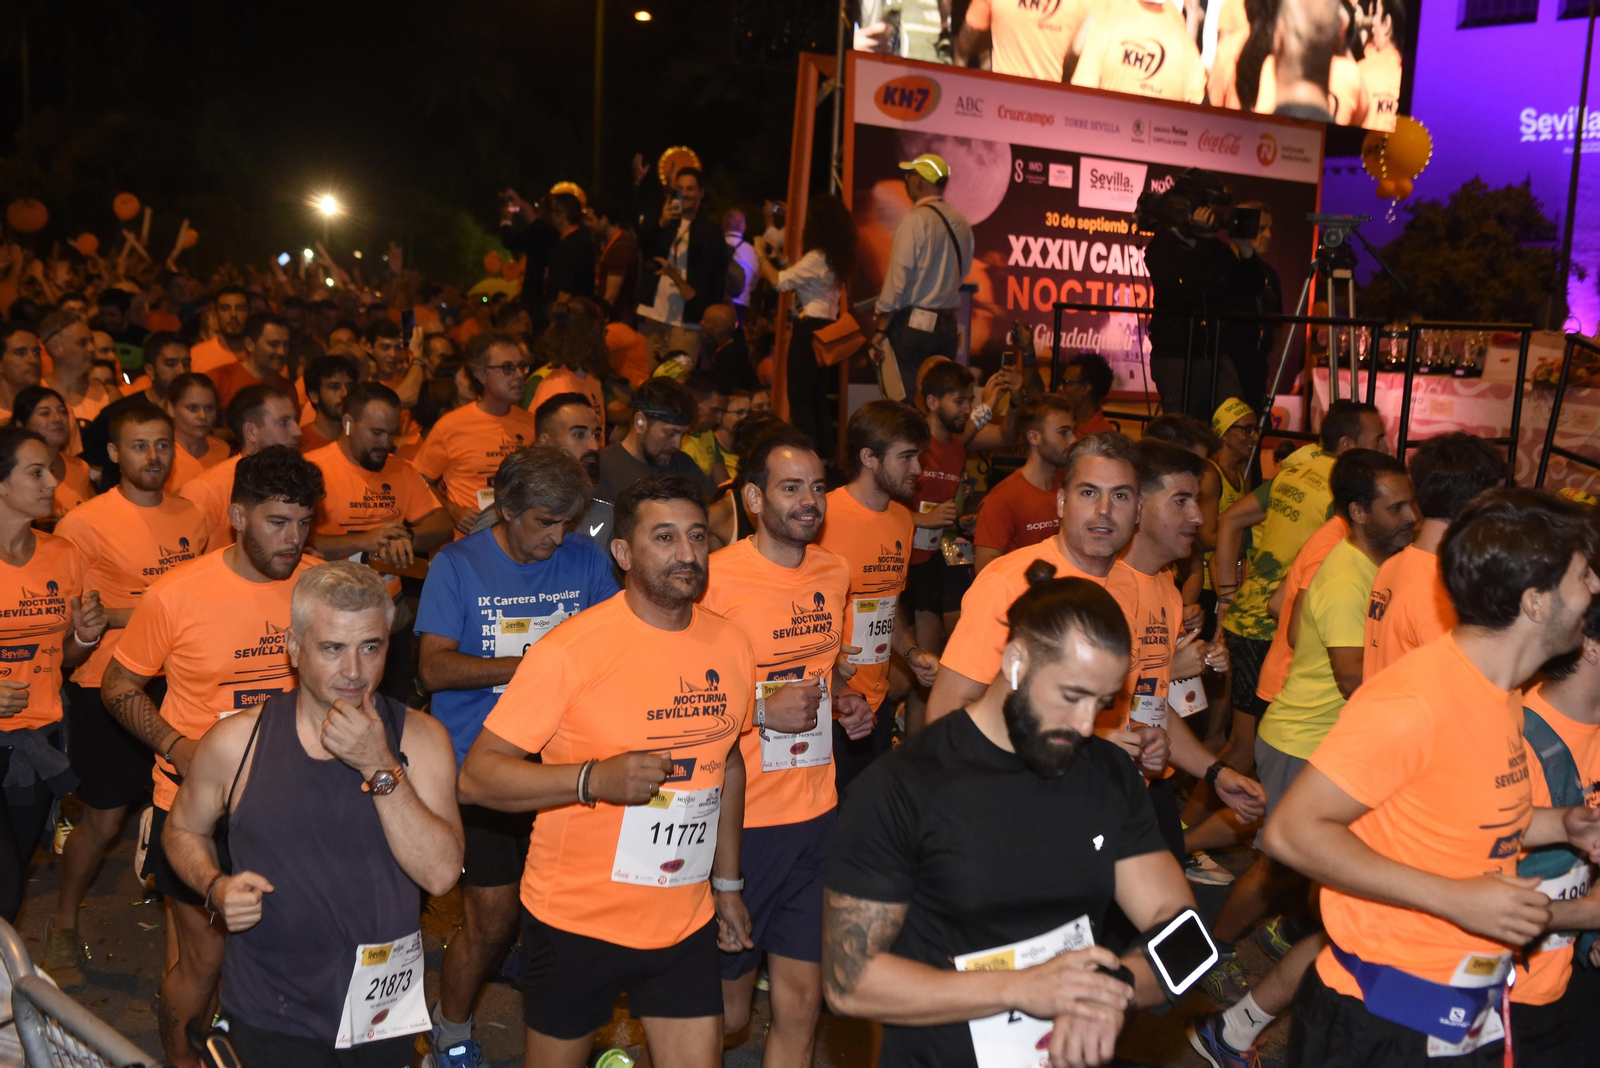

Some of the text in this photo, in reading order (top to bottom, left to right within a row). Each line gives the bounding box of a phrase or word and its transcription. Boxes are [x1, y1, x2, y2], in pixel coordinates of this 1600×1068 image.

[1122, 49, 1156, 73] KH7
[955, 96, 985, 113] ABC
[997, 105, 1055, 127] Cruzcampo
[1064, 117, 1120, 134] TORRE SEVILLA
[1045, 211, 1060, 227] 30
[1061, 214, 1076, 229] de
[1007, 234, 1089, 272] XXXIV
[1006, 275, 1155, 318] NOCTUR
[19, 598, 66, 608] NOCTURNA
[478, 590, 580, 607] IX Carrera Popular
[791, 613, 833, 626] NOCTURNA
[772, 624, 811, 640] SEVILLA
[234, 646, 285, 660] SEVILLA
[673, 693, 727, 706] NOCTURNA
[646, 704, 700, 721] SEVILLA
[650, 821, 707, 847] 11772
[364, 968, 413, 1001] 21873
